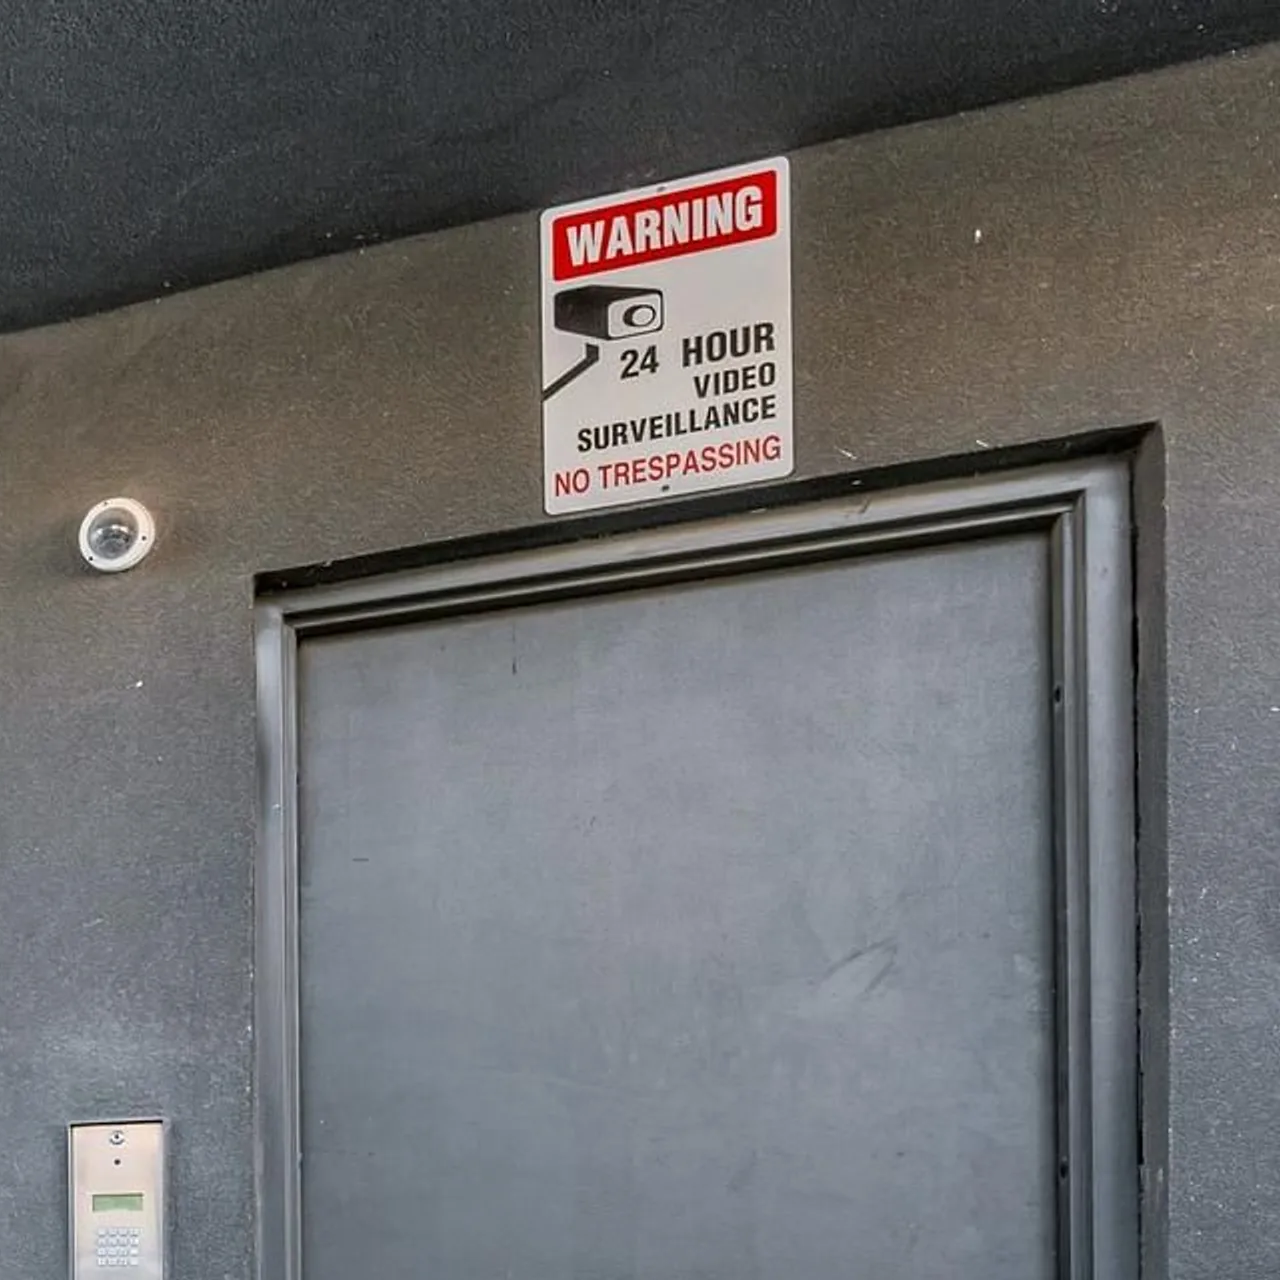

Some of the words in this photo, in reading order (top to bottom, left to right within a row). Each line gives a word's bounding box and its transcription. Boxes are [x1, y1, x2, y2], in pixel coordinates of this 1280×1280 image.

[566, 184, 763, 267] WARNING
[619, 345, 660, 380] 24
[682, 321, 776, 368] HOUR
[694, 361, 776, 399] VIDEO
[577, 394, 777, 453] SURVEILLANCE
[554, 467, 590, 497] NO
[597, 434, 782, 489] TRESPASSING
